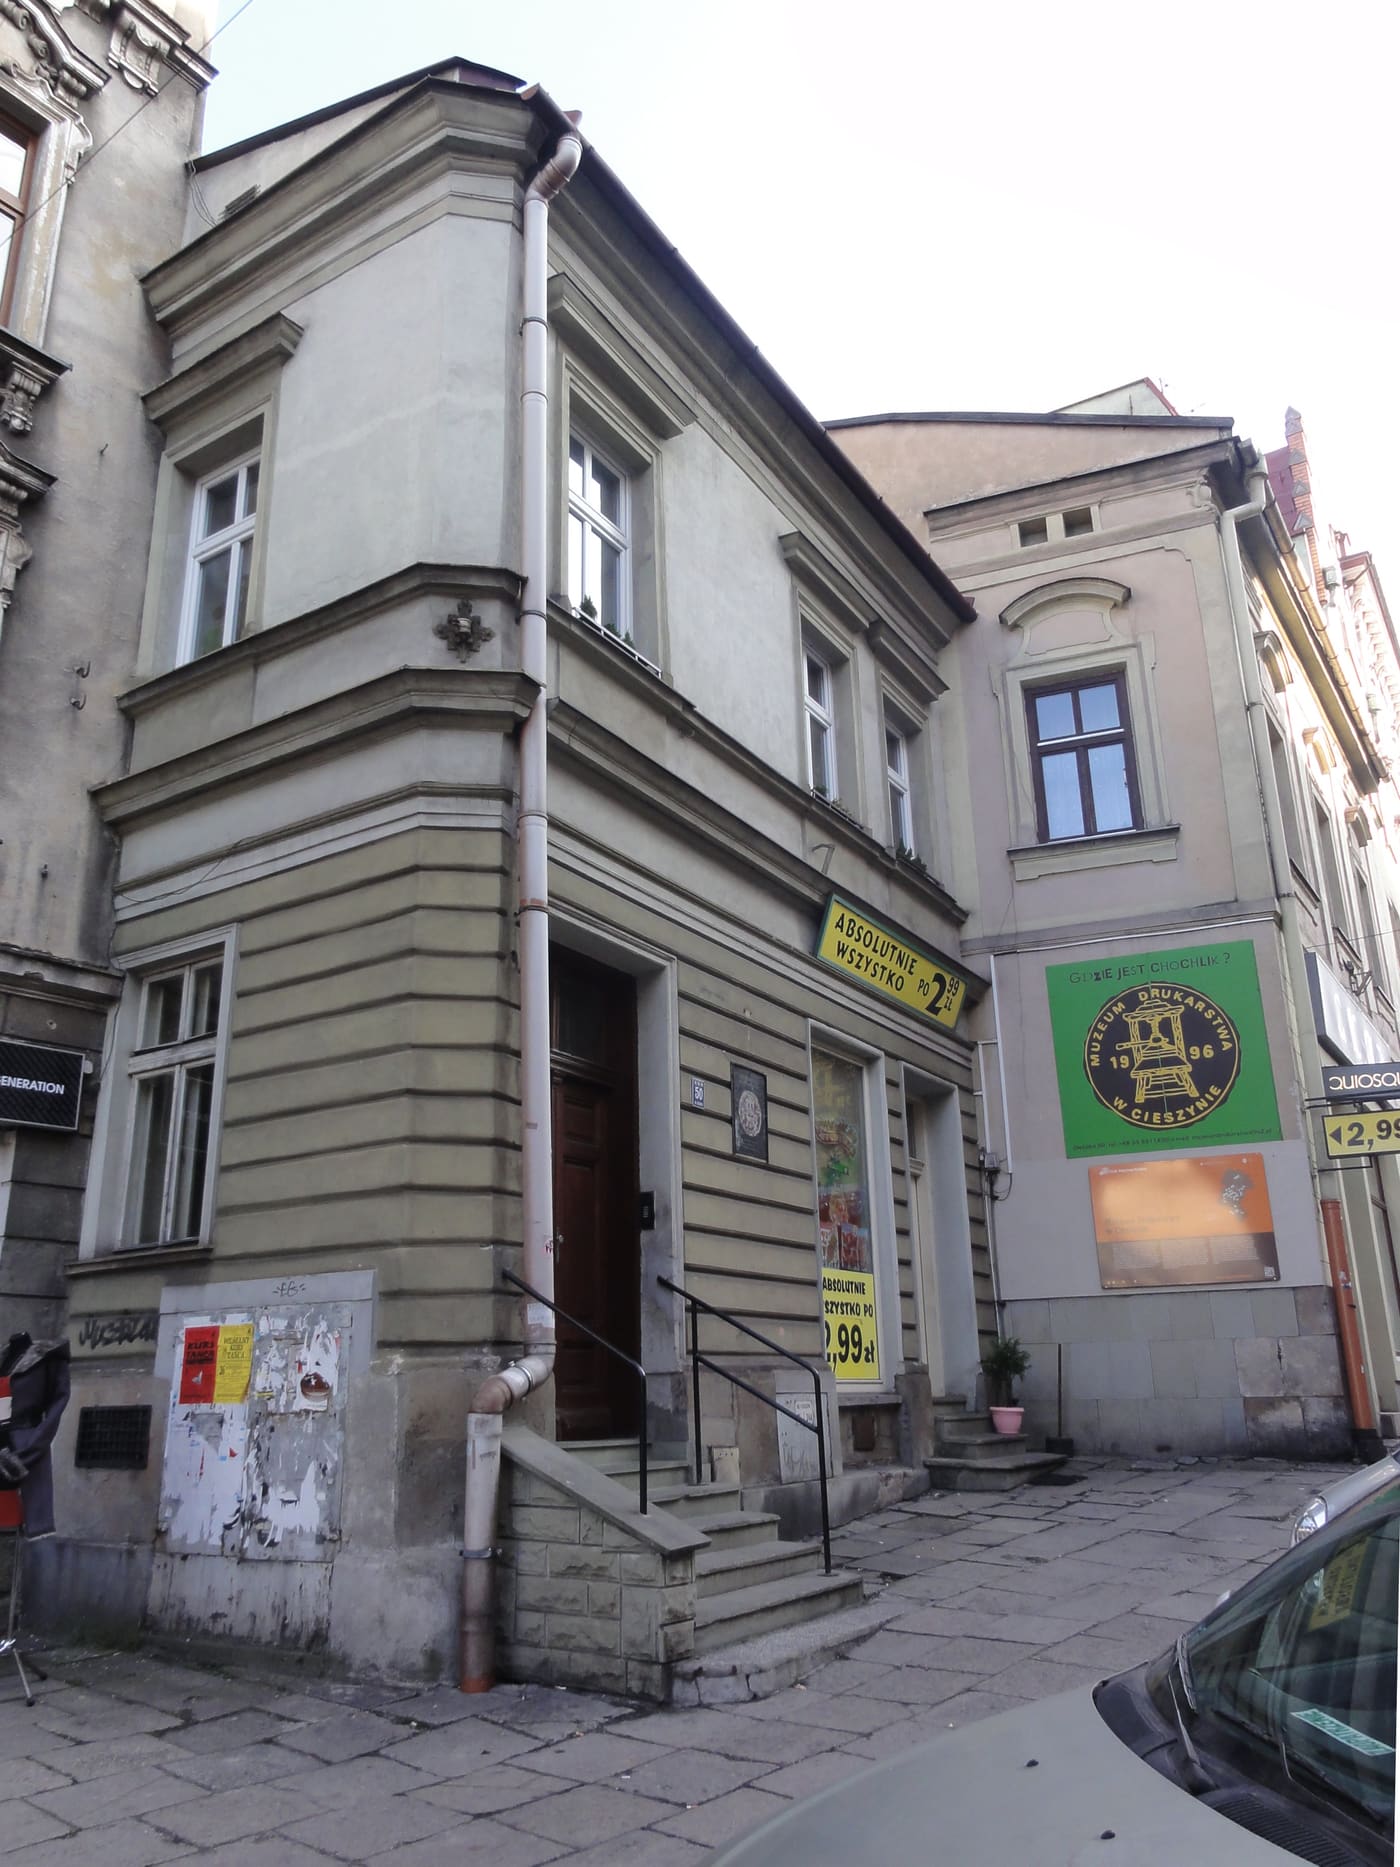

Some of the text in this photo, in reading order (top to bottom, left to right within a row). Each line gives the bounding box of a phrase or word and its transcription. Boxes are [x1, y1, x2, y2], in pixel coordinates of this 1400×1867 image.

[835, 913, 918, 976] ABSOLUTNIE
[836, 940, 930, 997] WSZYSTKO PO
[1069, 968, 1113, 984] GDZIE
[1116, 964, 1145, 981] JEST
[1150, 955, 1219, 973] CHOCHLIK
[1090, 1001, 1127, 1067] MUZEUM
[1137, 988, 1233, 1051] DRUKARSTWA
[1109, 1055, 1130, 1069] 19
[1189, 1044, 1215, 1060] 96
[0, 1075, 65, 1095] ENERATION
[1113, 1084, 1222, 1123] W CIESZYNIE
[822, 1277, 866, 1295] ABSOLUTNIE
[824, 1299, 874, 1318] SZYSTKO PO
